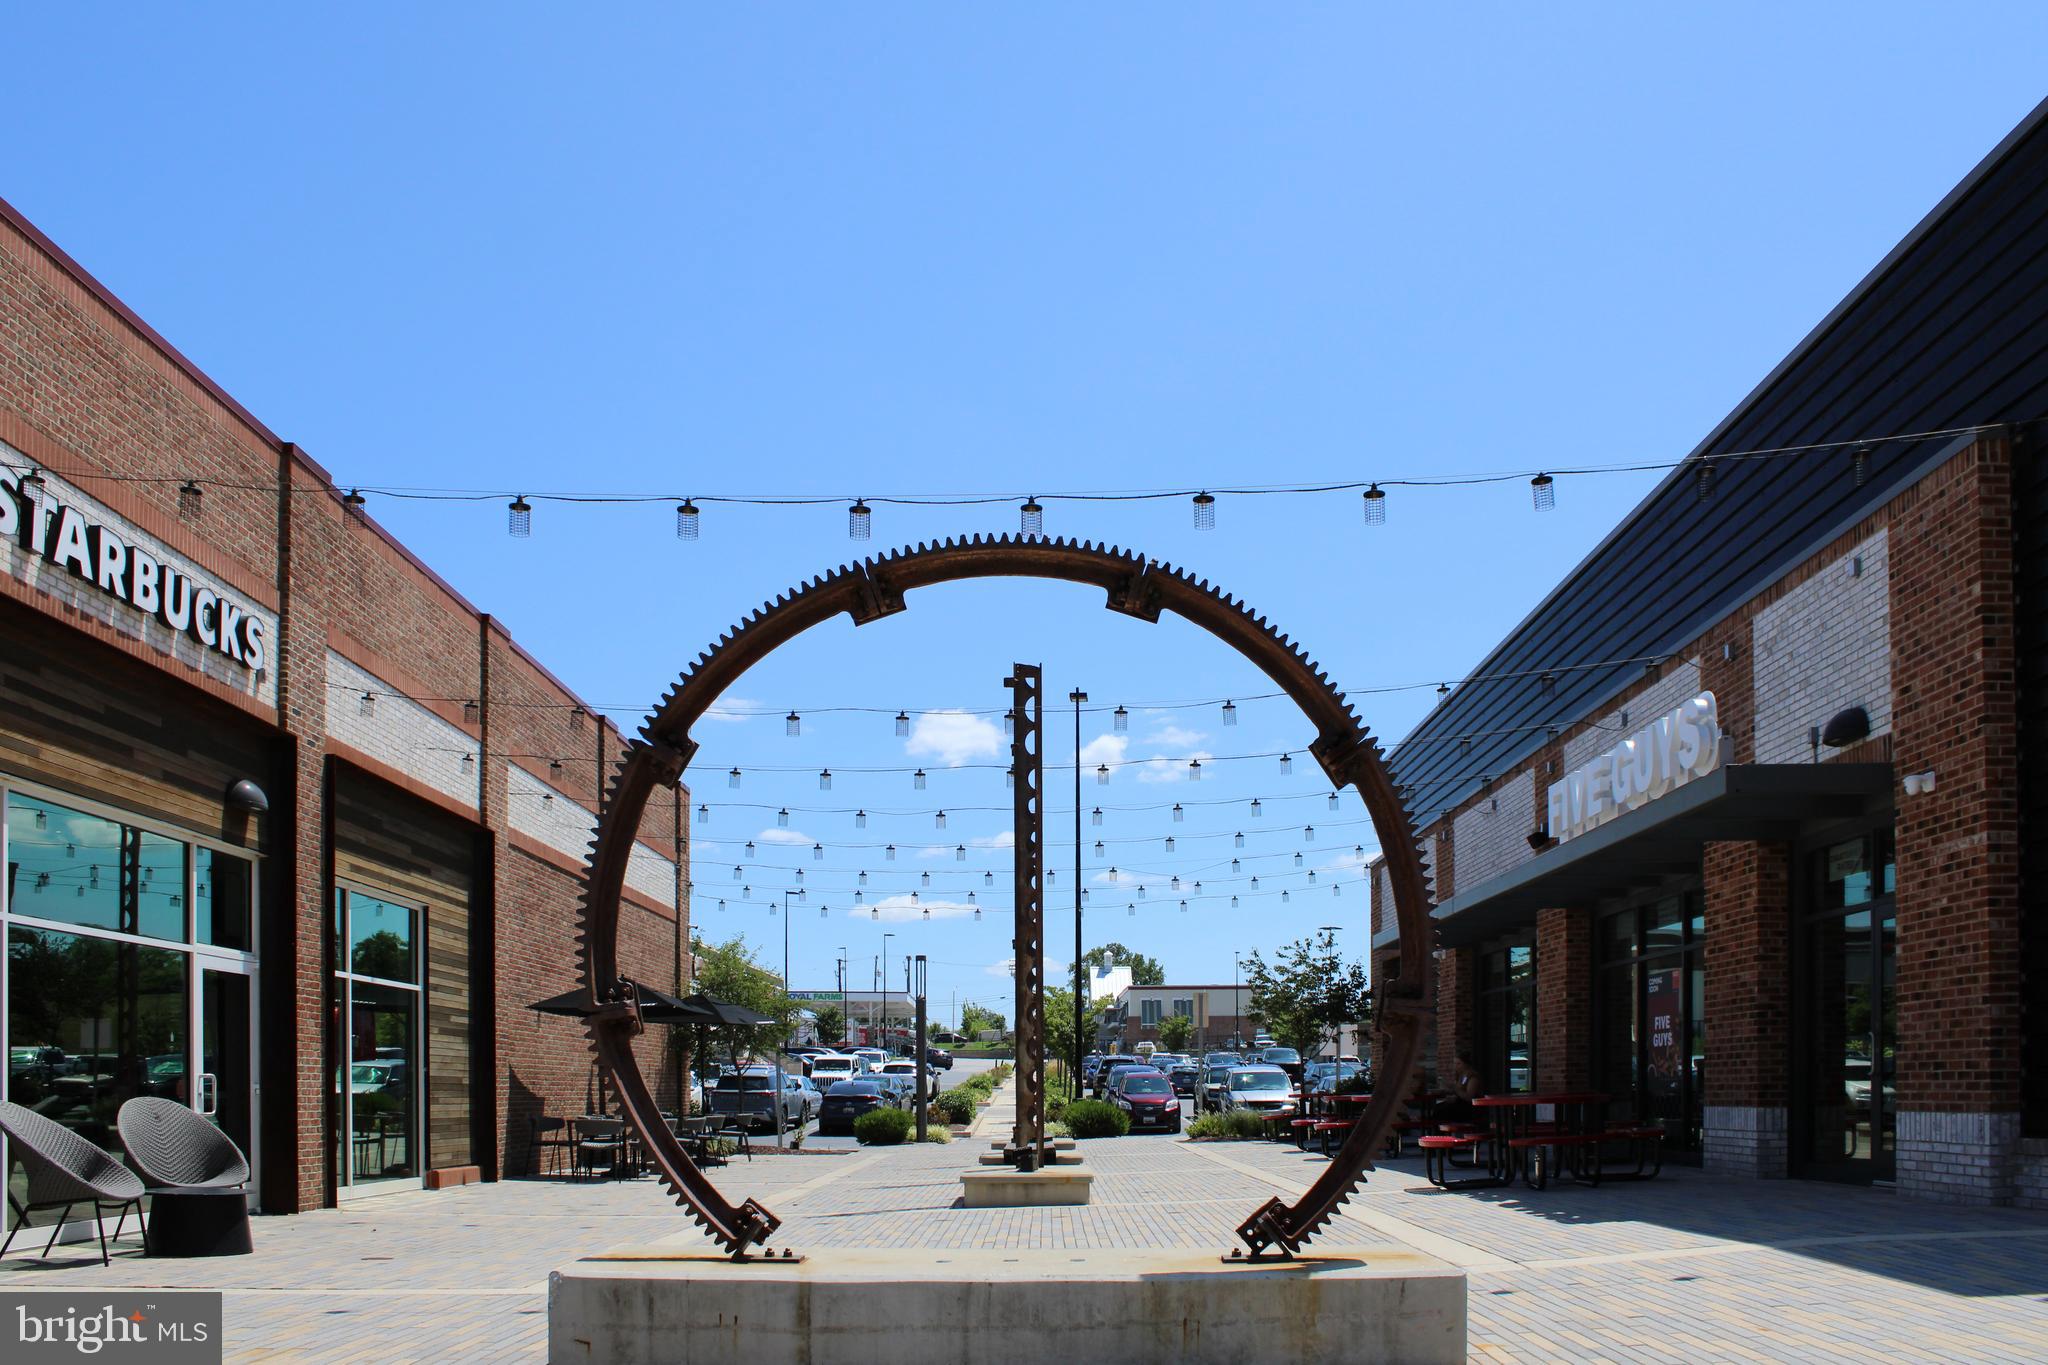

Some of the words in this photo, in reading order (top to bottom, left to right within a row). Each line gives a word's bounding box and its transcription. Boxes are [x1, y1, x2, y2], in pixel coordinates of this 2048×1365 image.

[0, 464, 264, 670] STARBUCKS
[1548, 755, 1612, 842] FIVE
[1611, 690, 1719, 808] GUYS
[787, 992, 812, 1000] OYAL
[813, 992, 843, 1000] FARMS
[1654, 1015, 1671, 1030] FIVE
[1653, 1032, 1673, 1047] GUYS
